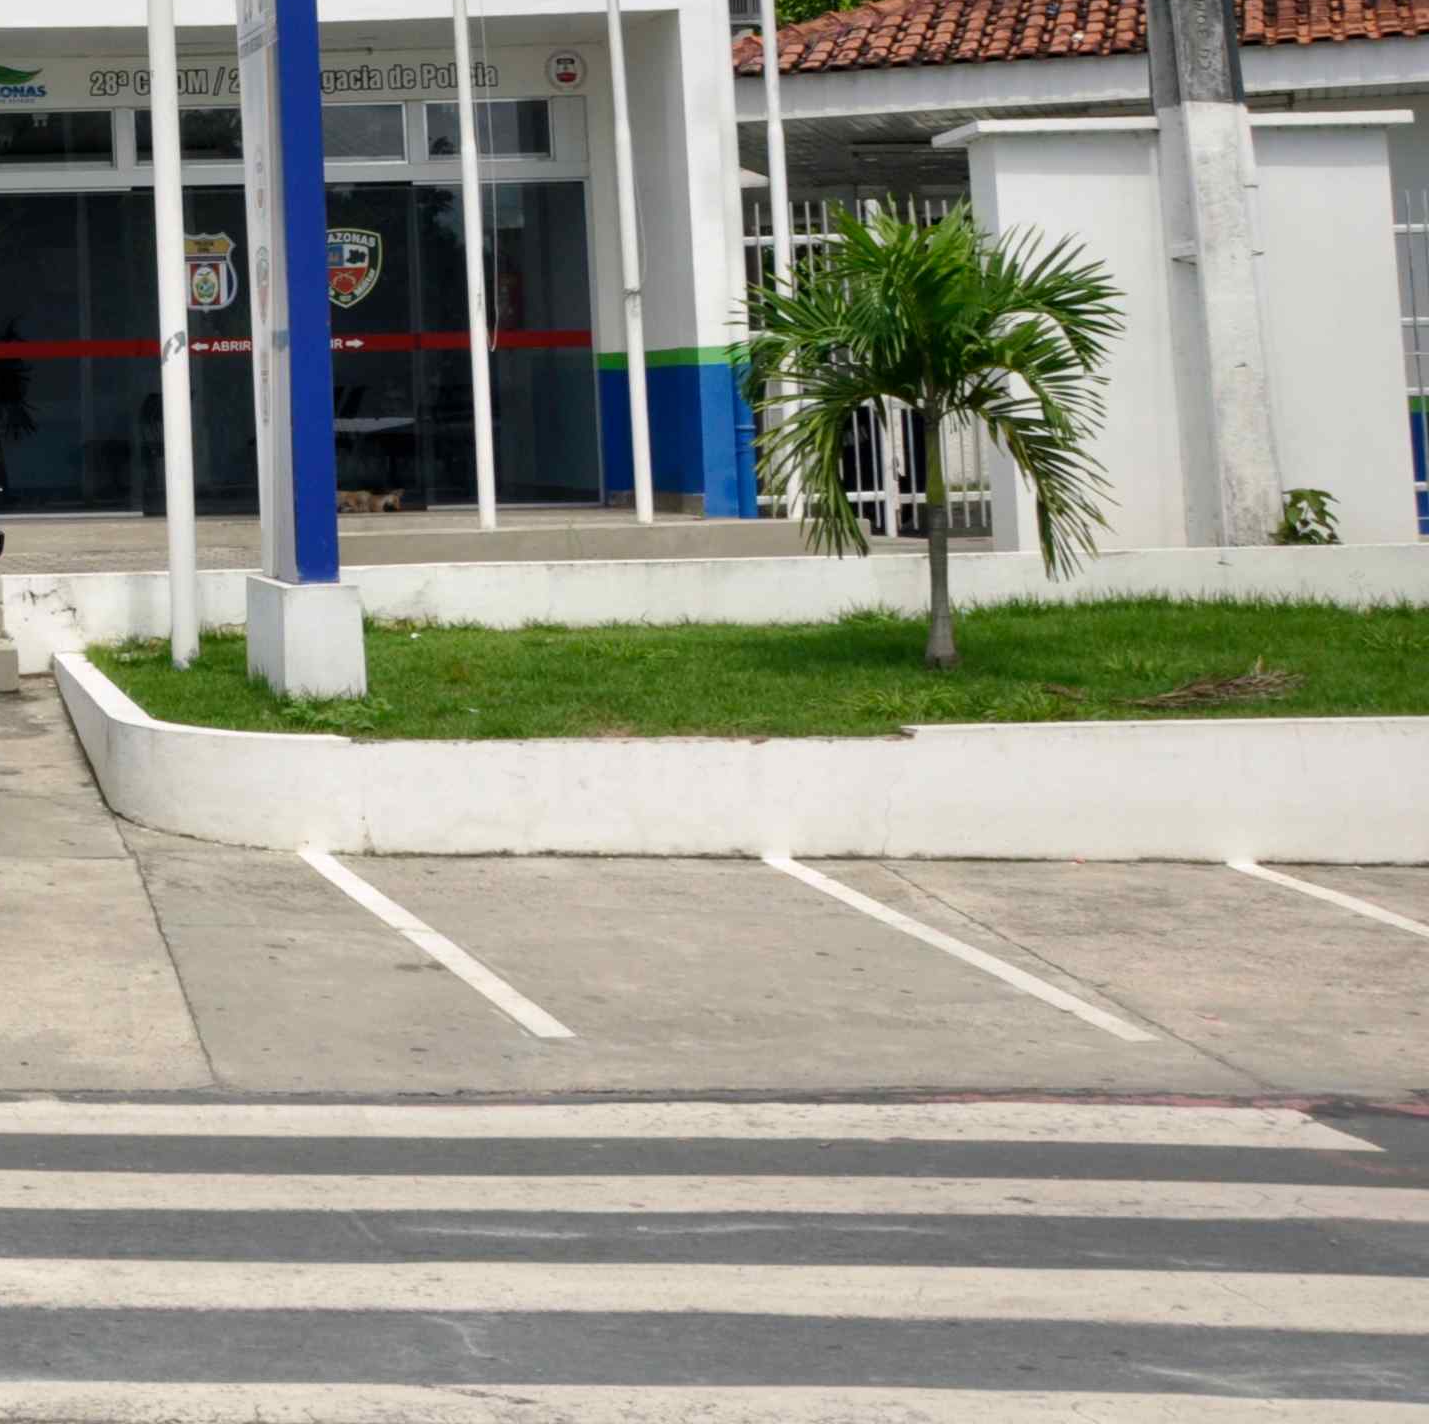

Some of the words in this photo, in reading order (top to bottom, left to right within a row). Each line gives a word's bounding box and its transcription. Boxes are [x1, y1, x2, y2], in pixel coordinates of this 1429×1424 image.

[388, 63, 417, 89] de
[327, 232, 377, 248] AZONAS
[211, 340, 253, 353] ABRIR
